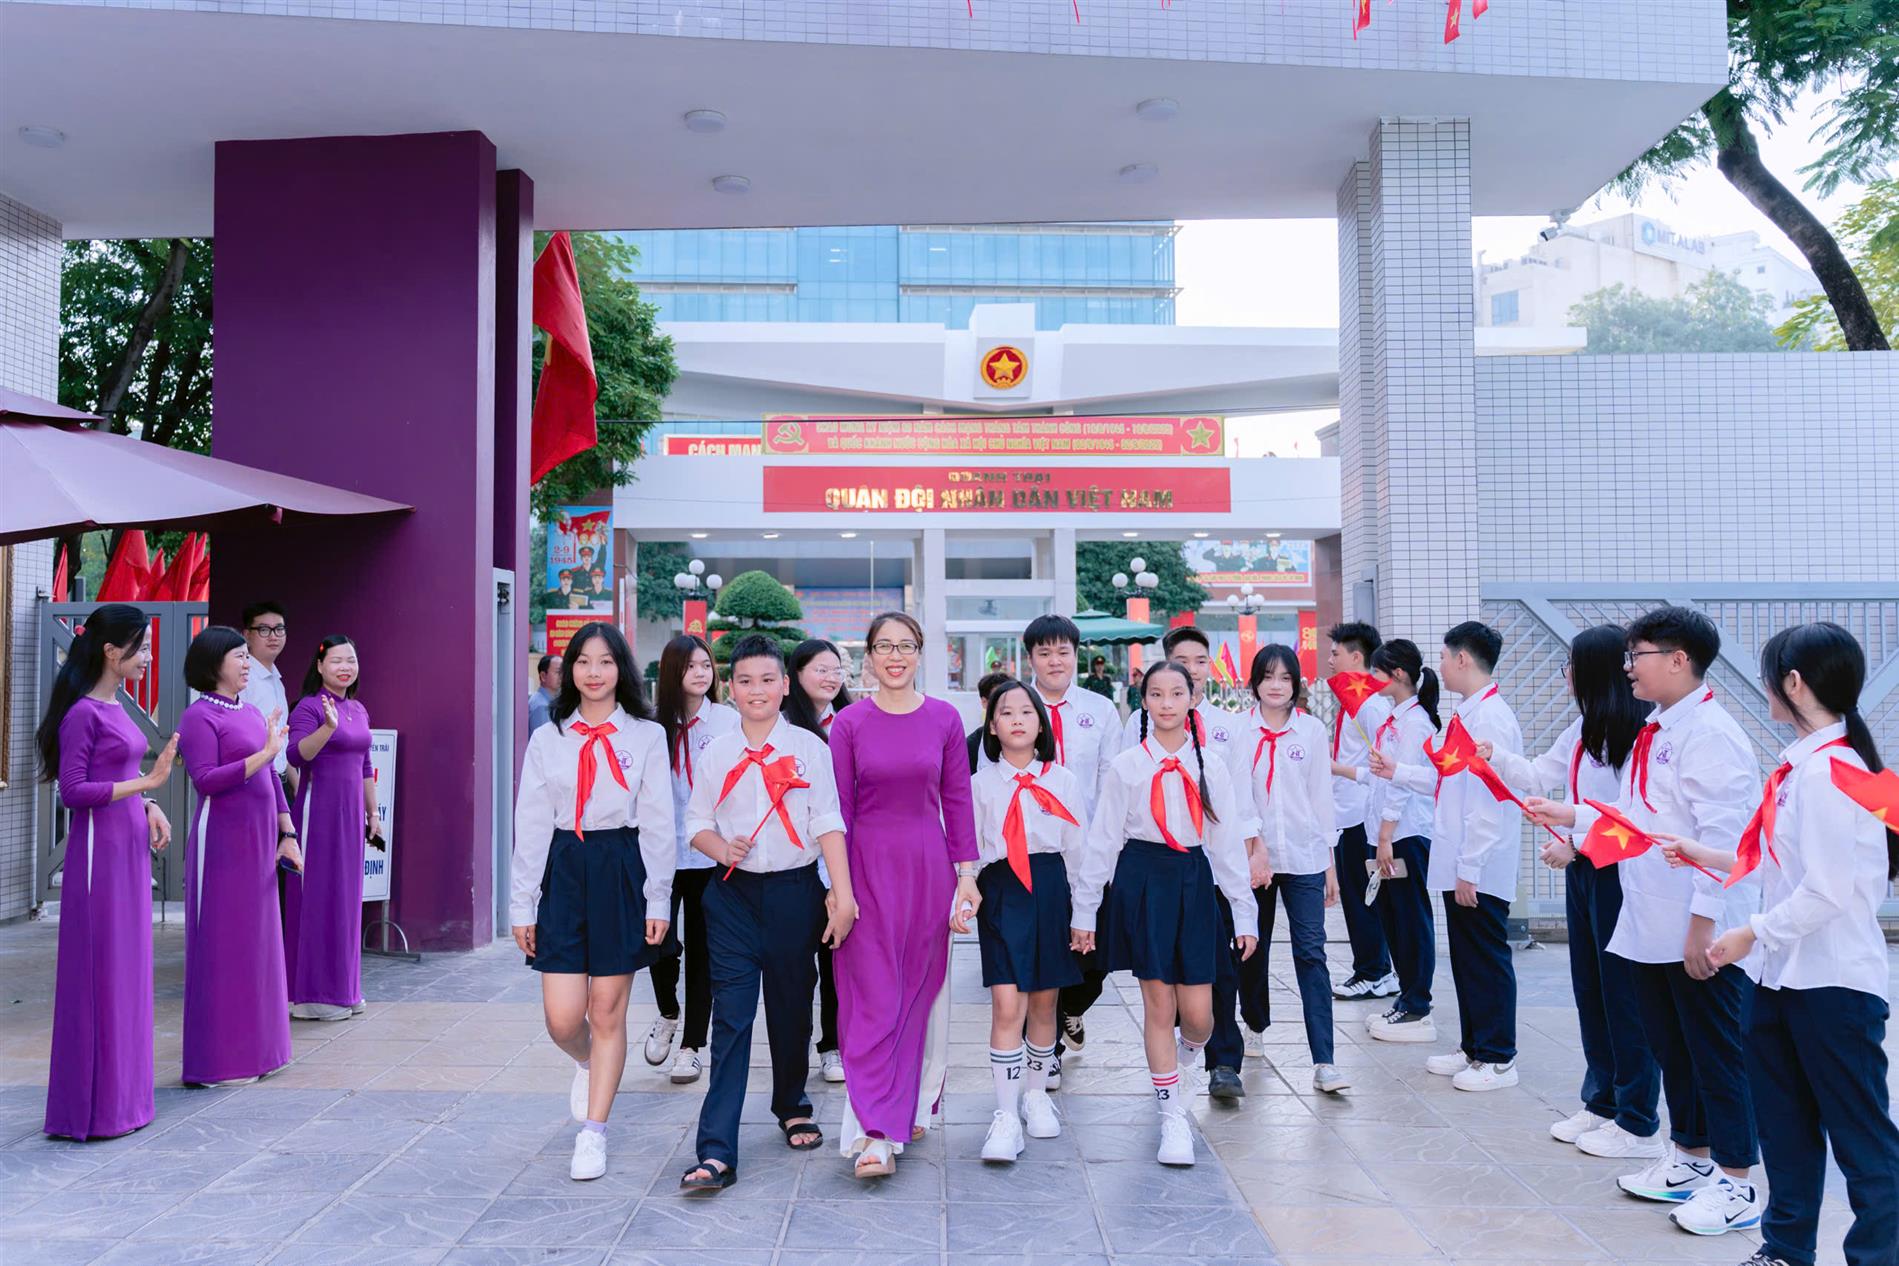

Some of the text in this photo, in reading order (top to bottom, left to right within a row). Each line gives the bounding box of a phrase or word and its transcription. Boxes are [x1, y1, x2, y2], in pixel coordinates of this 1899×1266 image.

[825, 484, 1174, 512] QUÂN ĐỘI NHÂN DÂN VIỆT NAM
[364, 860, 384, 879] ĐỊNH
[1006, 1066, 1020, 1081] 12
